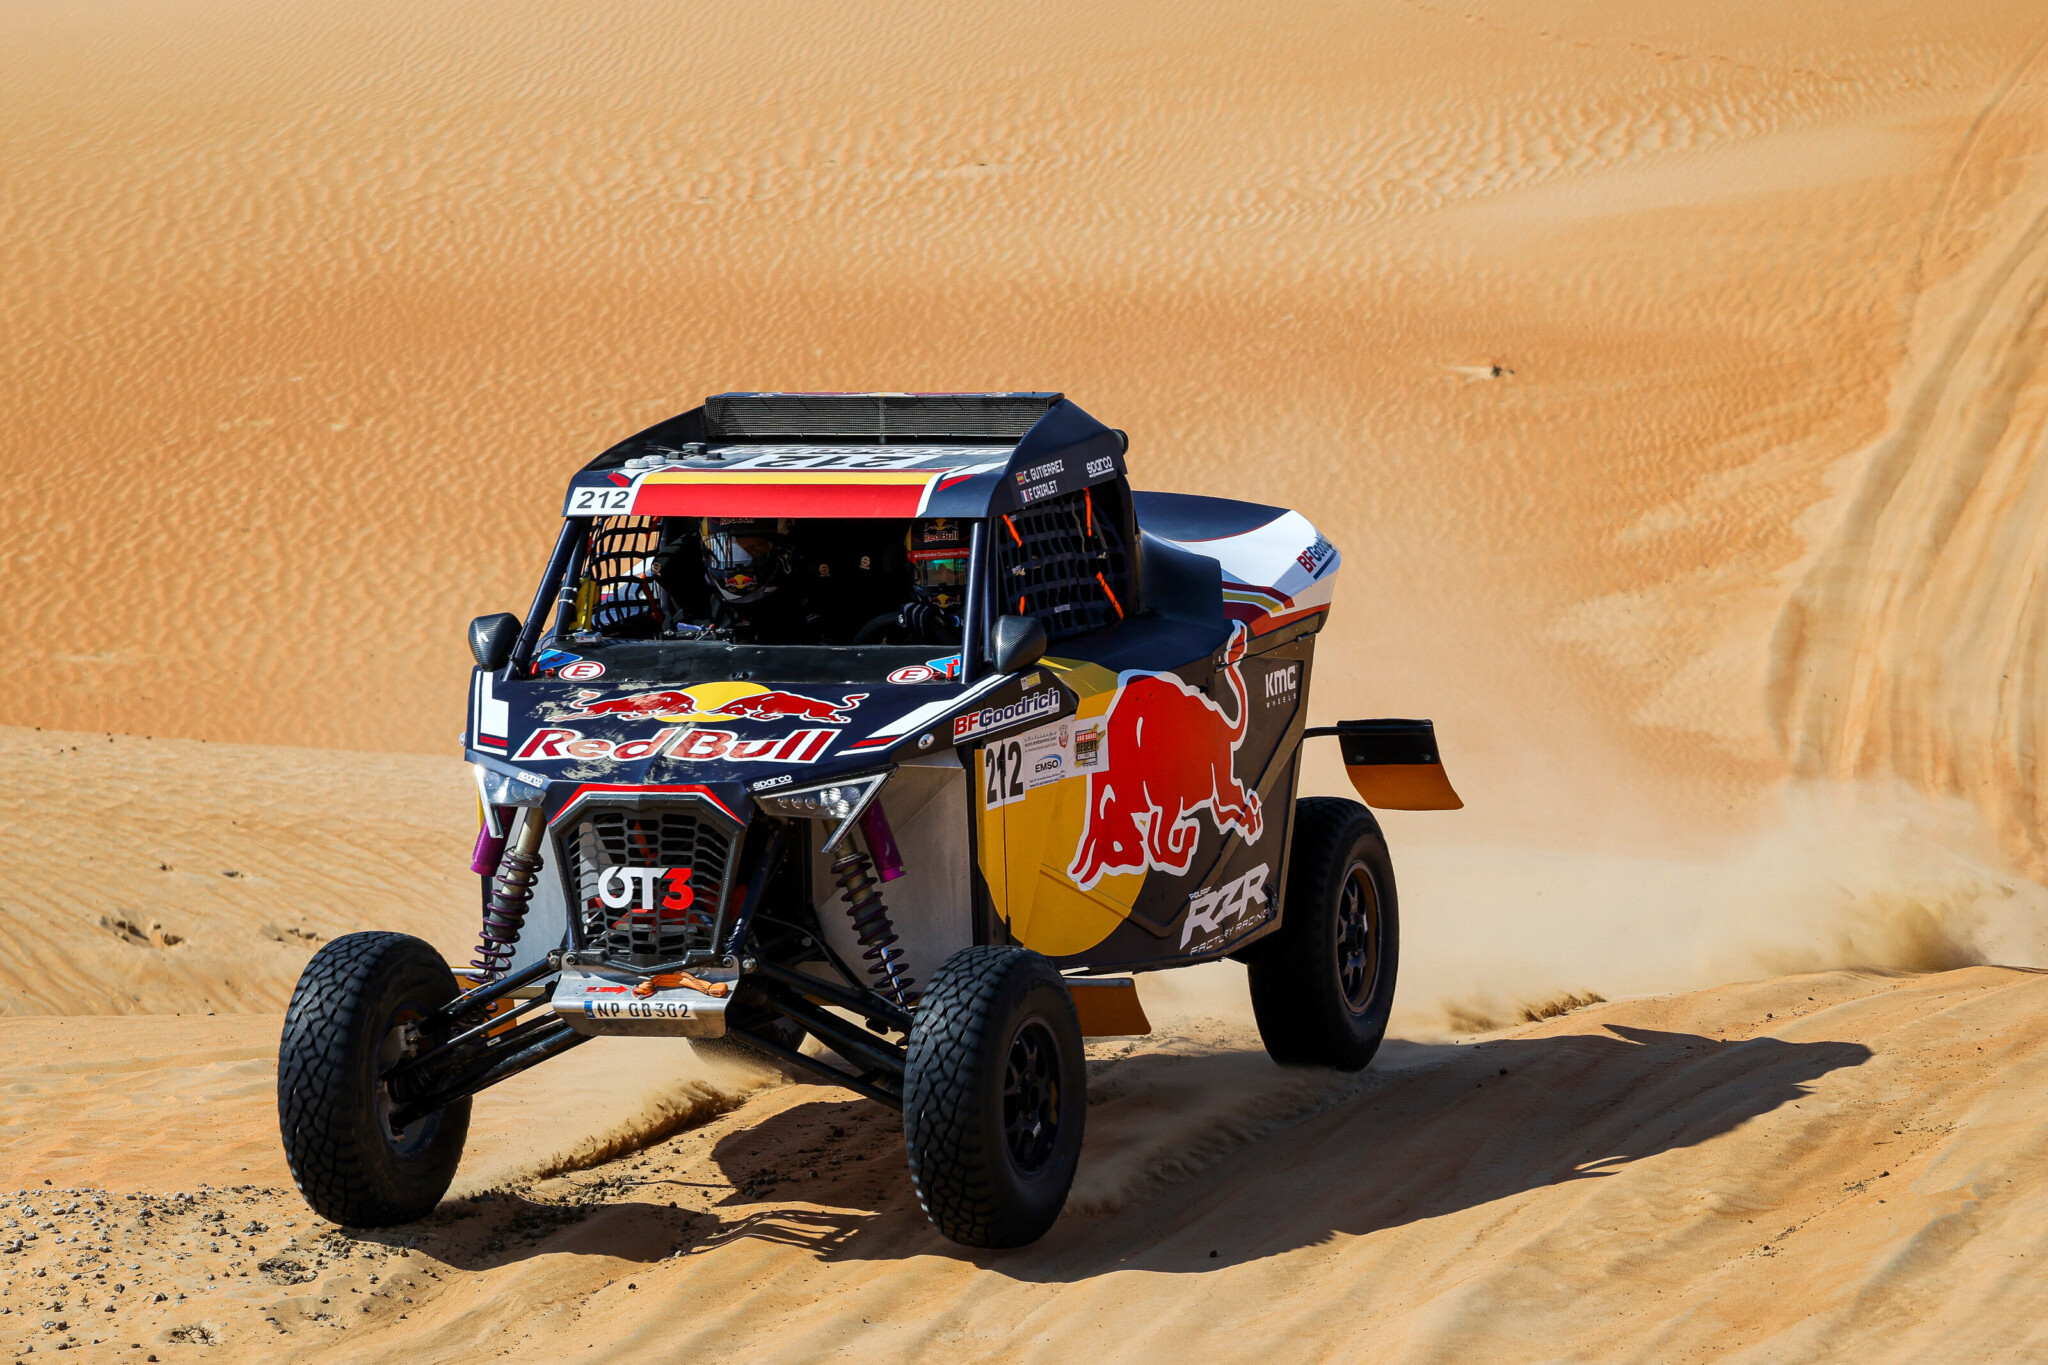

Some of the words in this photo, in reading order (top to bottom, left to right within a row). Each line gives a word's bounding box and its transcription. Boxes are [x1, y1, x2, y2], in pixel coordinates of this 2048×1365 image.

[1030, 459, 1064, 481] GUTIERREZ
[1086, 456, 1113, 475] sparco
[1033, 480, 1058, 499] CAZALET
[576, 490, 630, 509] 212
[923, 532, 941, 543] Red
[940, 530, 959, 541] Bull
[571, 665, 594, 676] E
[900, 669, 923, 680] E
[954, 687, 1060, 737] BFGoodrich
[511, 727, 682, 762] Red
[662, 728, 842, 764] Bull
[985, 740, 1024, 805] 212
[1035, 760, 1059, 773] EMSO
[518, 771, 544, 787] sparco
[752, 775, 793, 790] sparco
[598, 866, 695, 911] OT3
[1180, 862, 1270, 951] RZR
